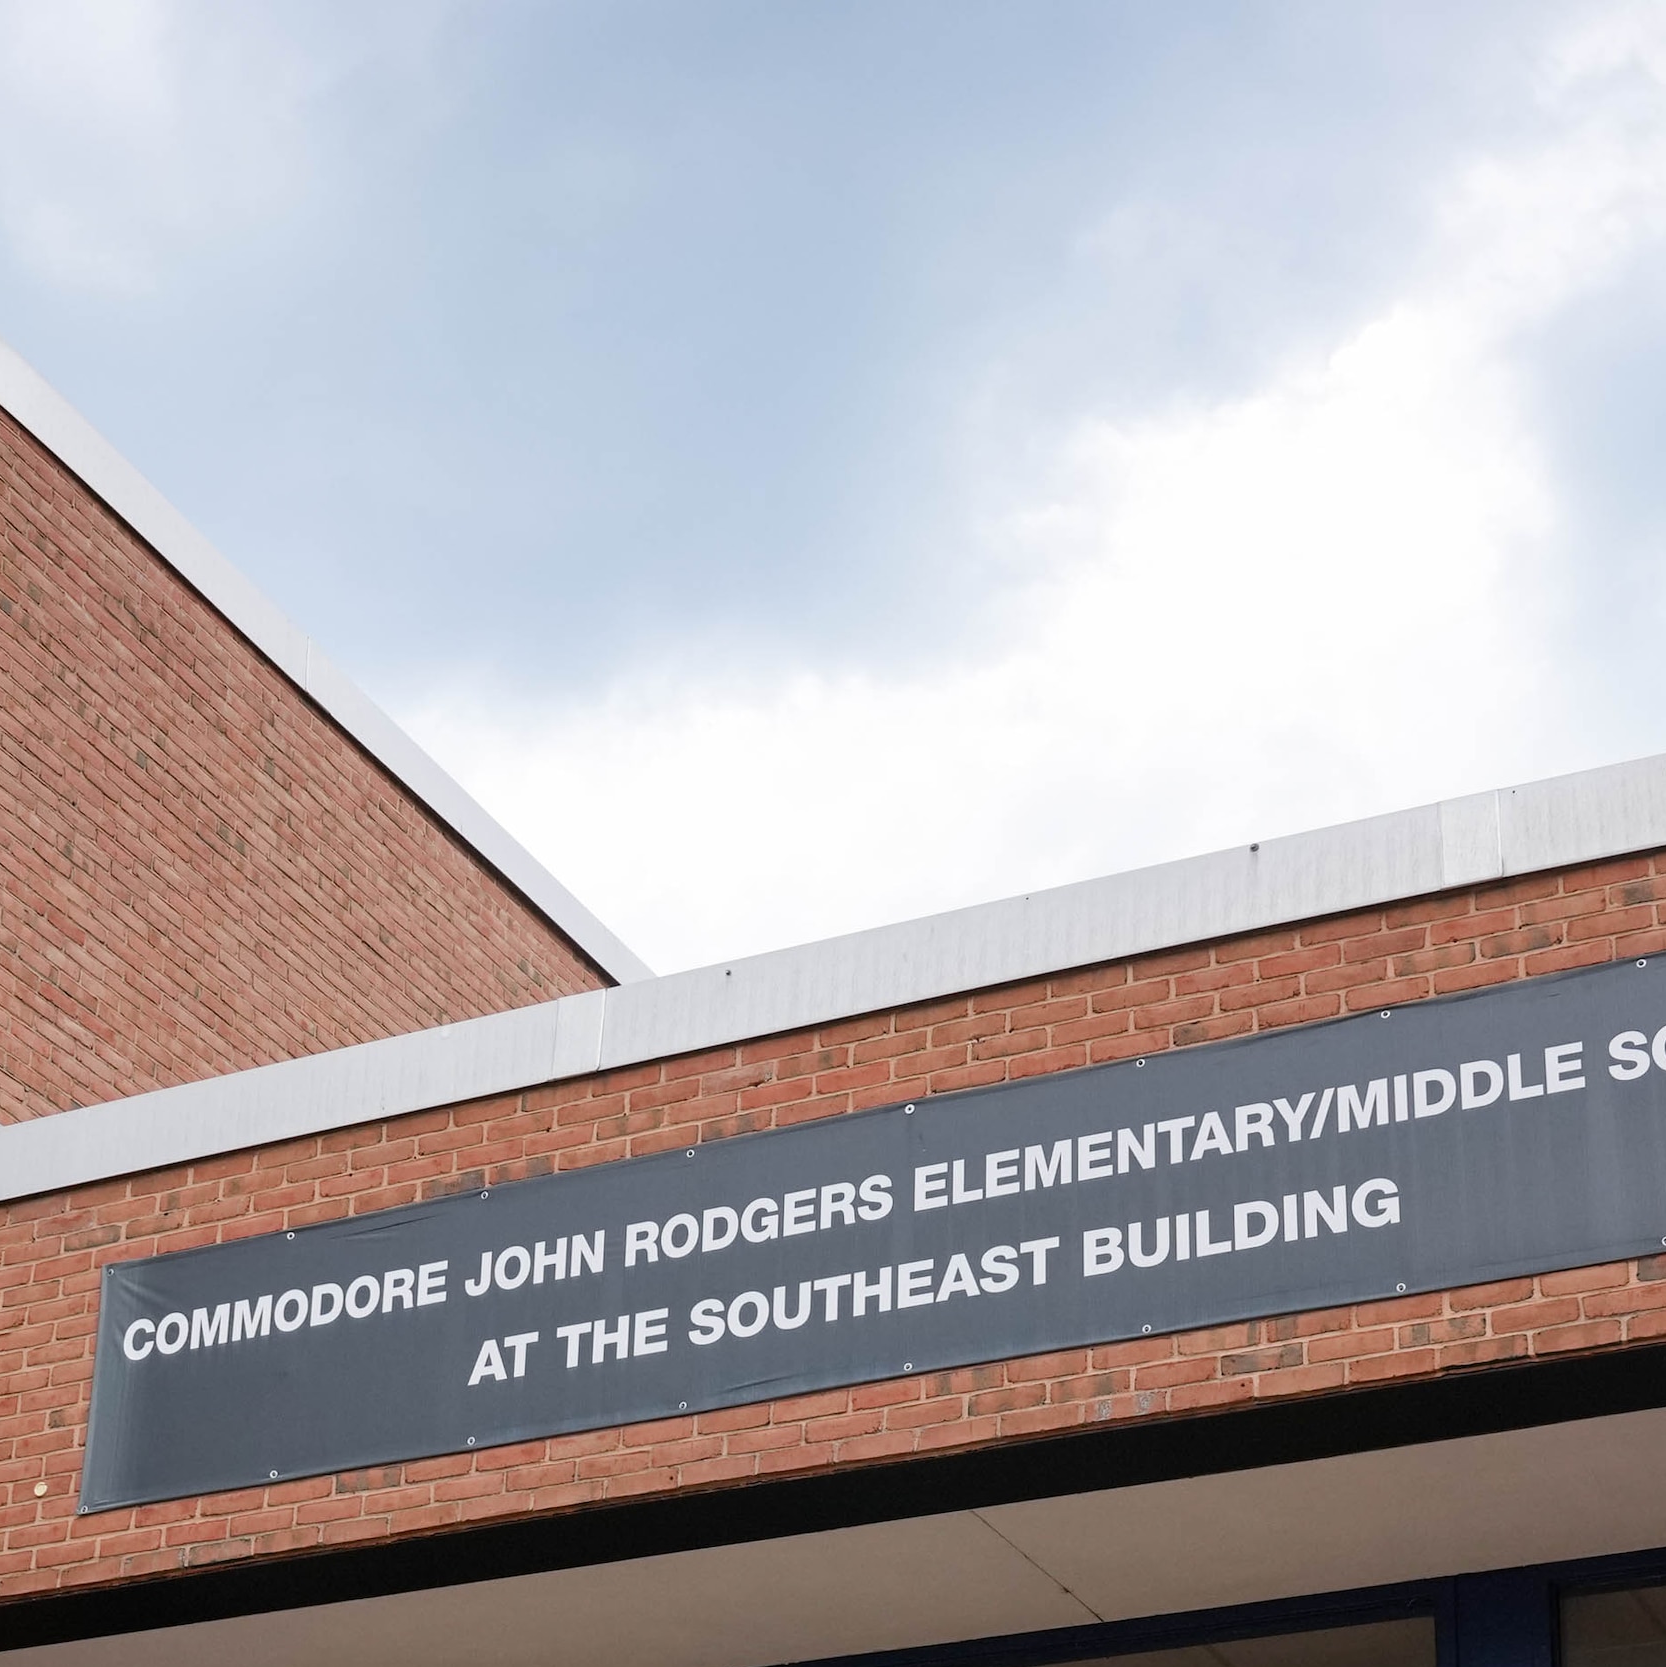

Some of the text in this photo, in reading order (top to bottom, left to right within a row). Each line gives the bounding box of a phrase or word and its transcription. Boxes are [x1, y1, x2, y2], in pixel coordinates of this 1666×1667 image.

[122, 1259, 450, 1363] COMMODORE
[463, 1230, 607, 1298] JOHN
[623, 1175, 895, 1268] RODGERS
[911, 1037, 1587, 1215] ELEMENTARY/MIDDLE
[467, 1176, 1401, 1388] AT THE SOUTHEAST BUILDING
